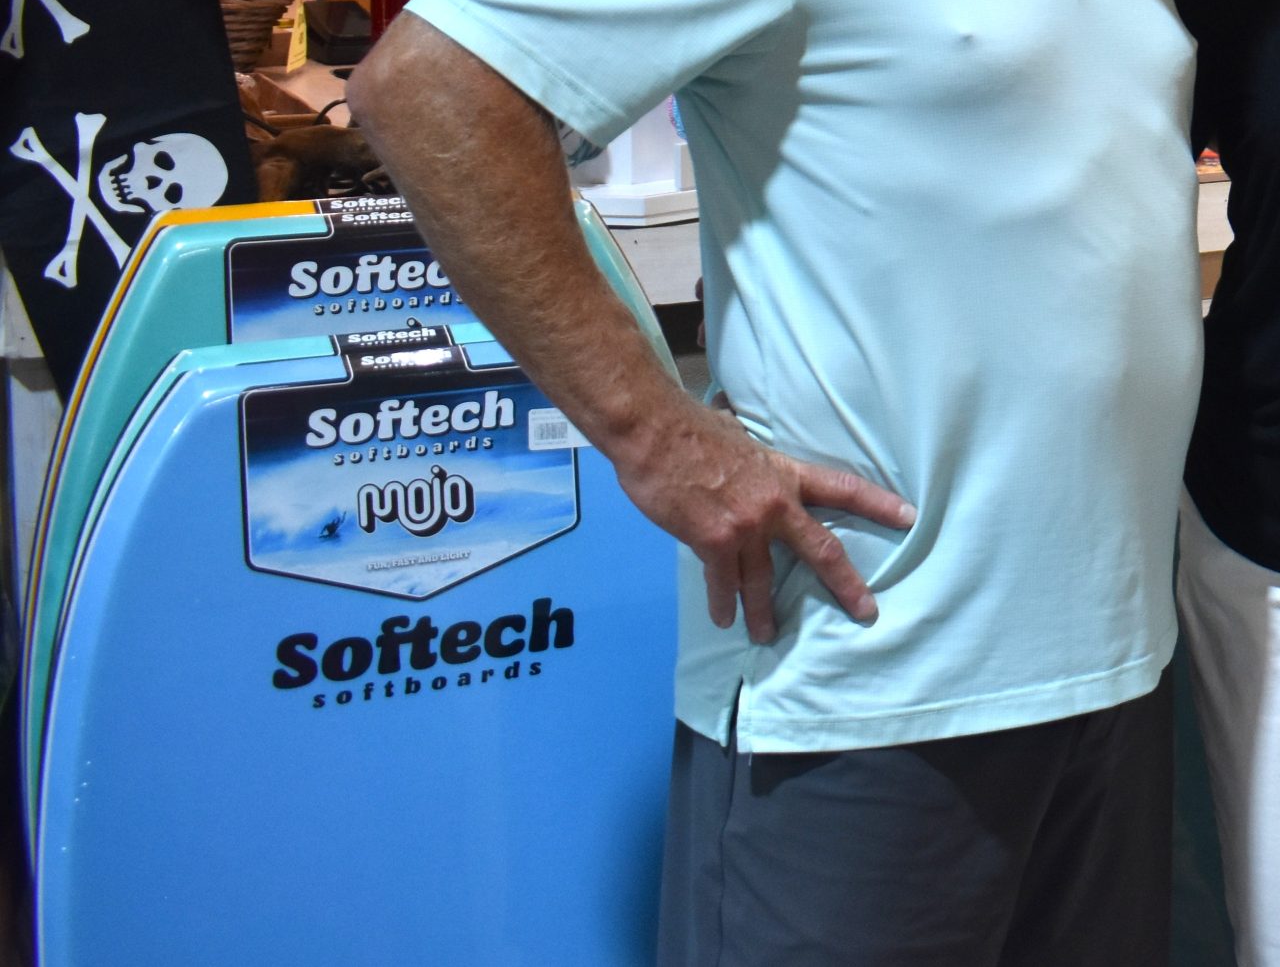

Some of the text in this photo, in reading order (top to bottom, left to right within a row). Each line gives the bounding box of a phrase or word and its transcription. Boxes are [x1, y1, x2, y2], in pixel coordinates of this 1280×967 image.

[330, 197, 406, 209] Softec
[341, 211, 414, 222] Softec
[288, 254, 450, 298] Softec
[347, 328, 437, 343] Softech
[305, 391, 514, 449] Softech
[334, 436, 493, 465] softboards
[357, 465, 475, 537] mojo
[391, 556, 418, 567] FAST
[418, 554, 439, 564] AND
[440, 549, 471, 562] LIGHT
[272, 596, 575, 690] Softech
[312, 660, 542, 709] softboards
